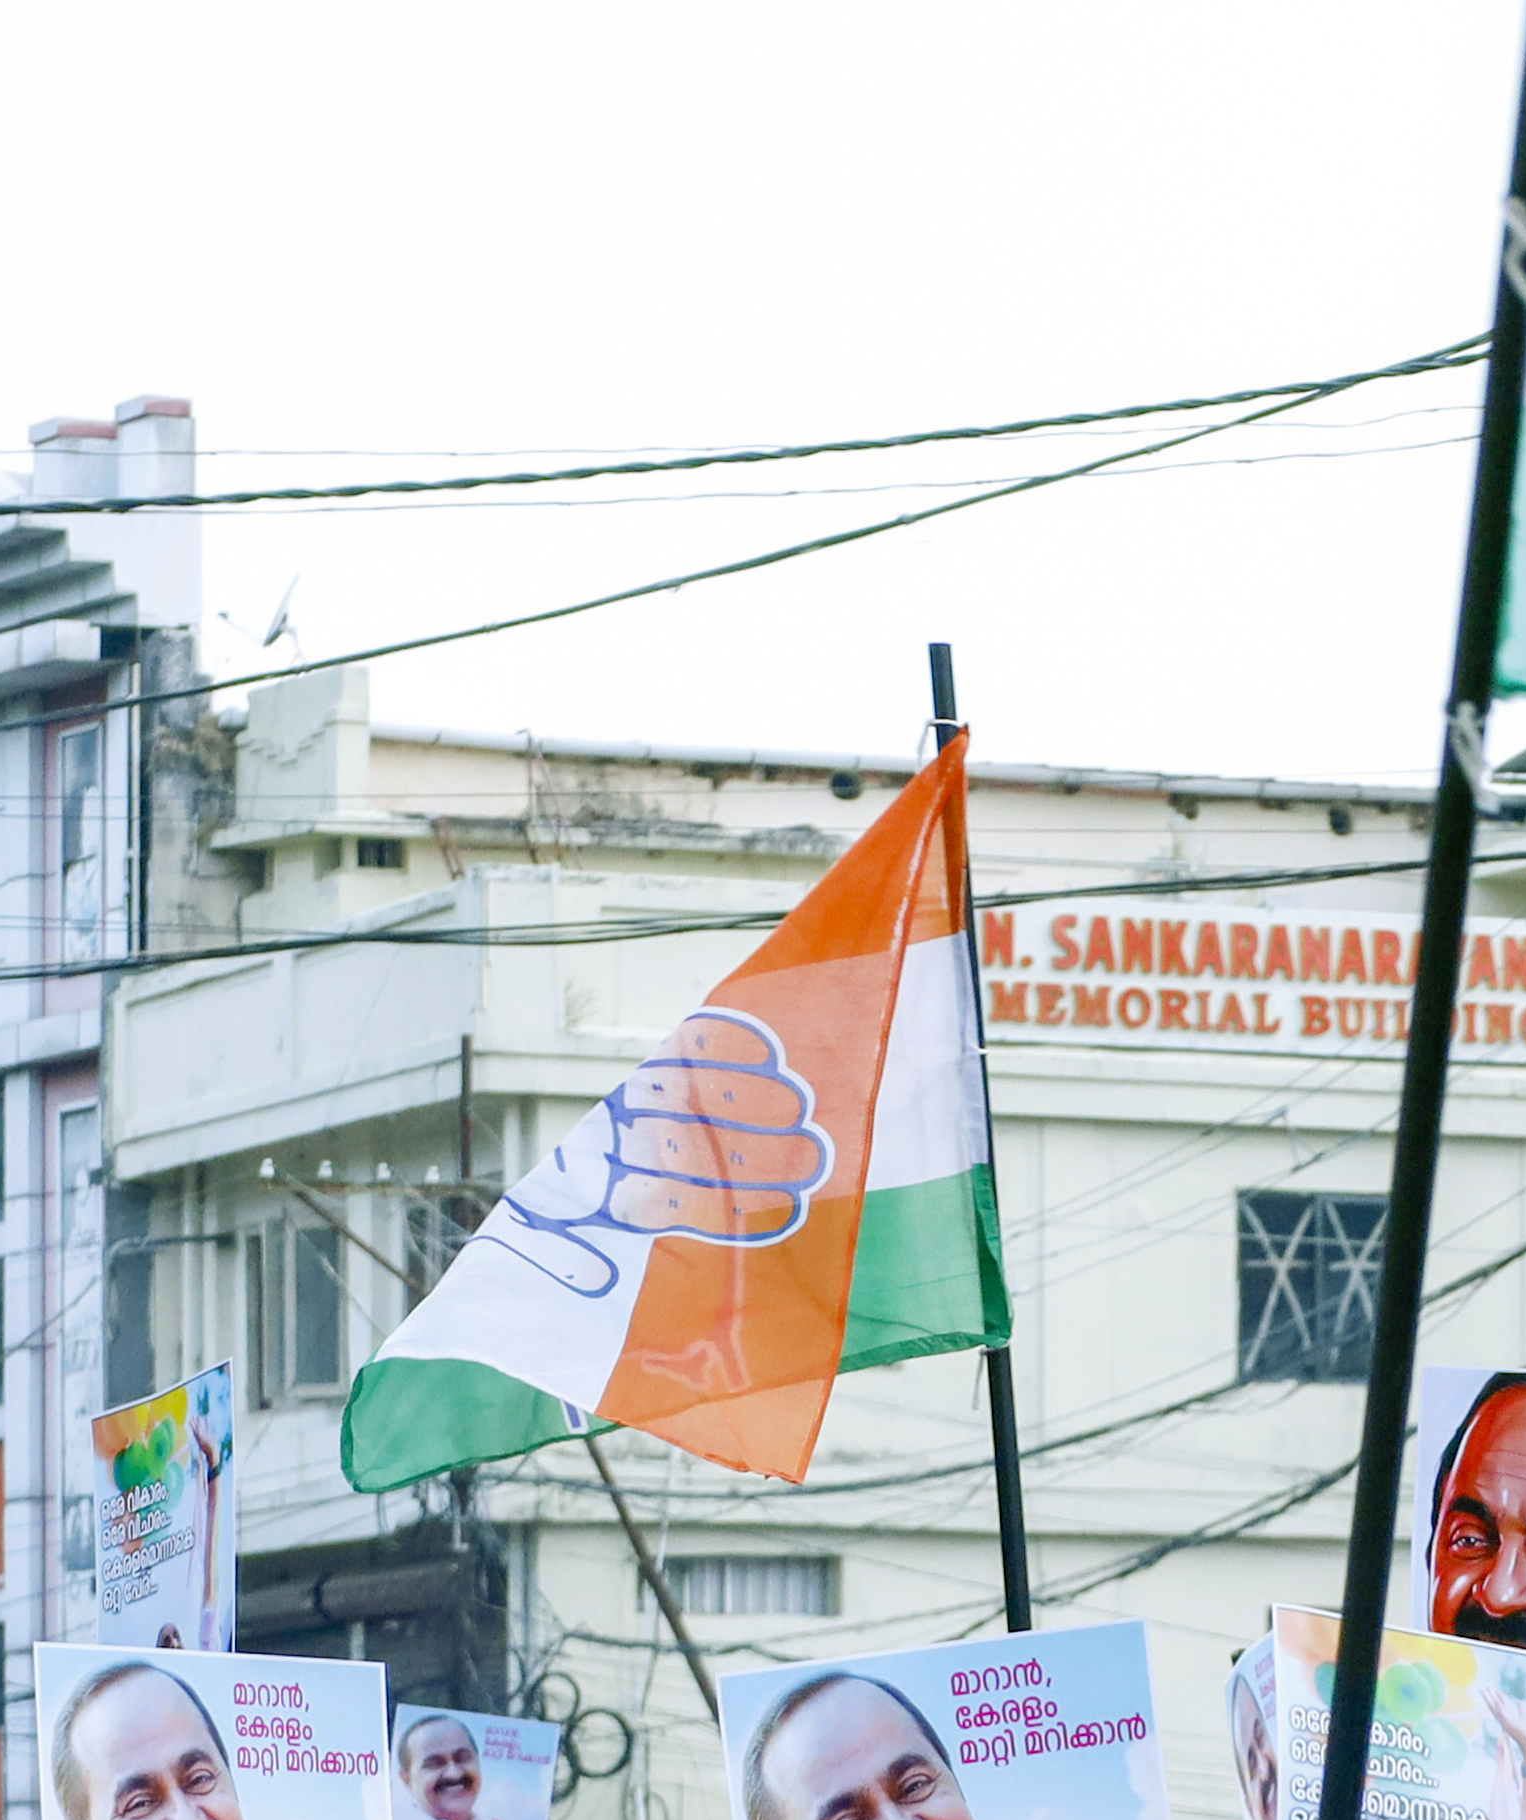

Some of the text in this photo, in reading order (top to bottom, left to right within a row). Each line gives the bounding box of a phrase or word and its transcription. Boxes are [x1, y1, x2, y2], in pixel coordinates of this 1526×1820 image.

[982, 911, 1034, 969] N.
[988, 981, 1282, 1037] MEMORIAL
[950, 1658, 1052, 1697] മാറാൻ,
[234, 1682, 310, 1714] മാറാൻ,
[955, 1697, 1058, 1731] കേരളം
[234, 1714, 313, 1746] കേരളം
[959, 1712, 1146, 1767] മാറ്റി മറിക്കാൻ
[235, 1742, 379, 1777] മാറ്റി മറിക്കാൻ
